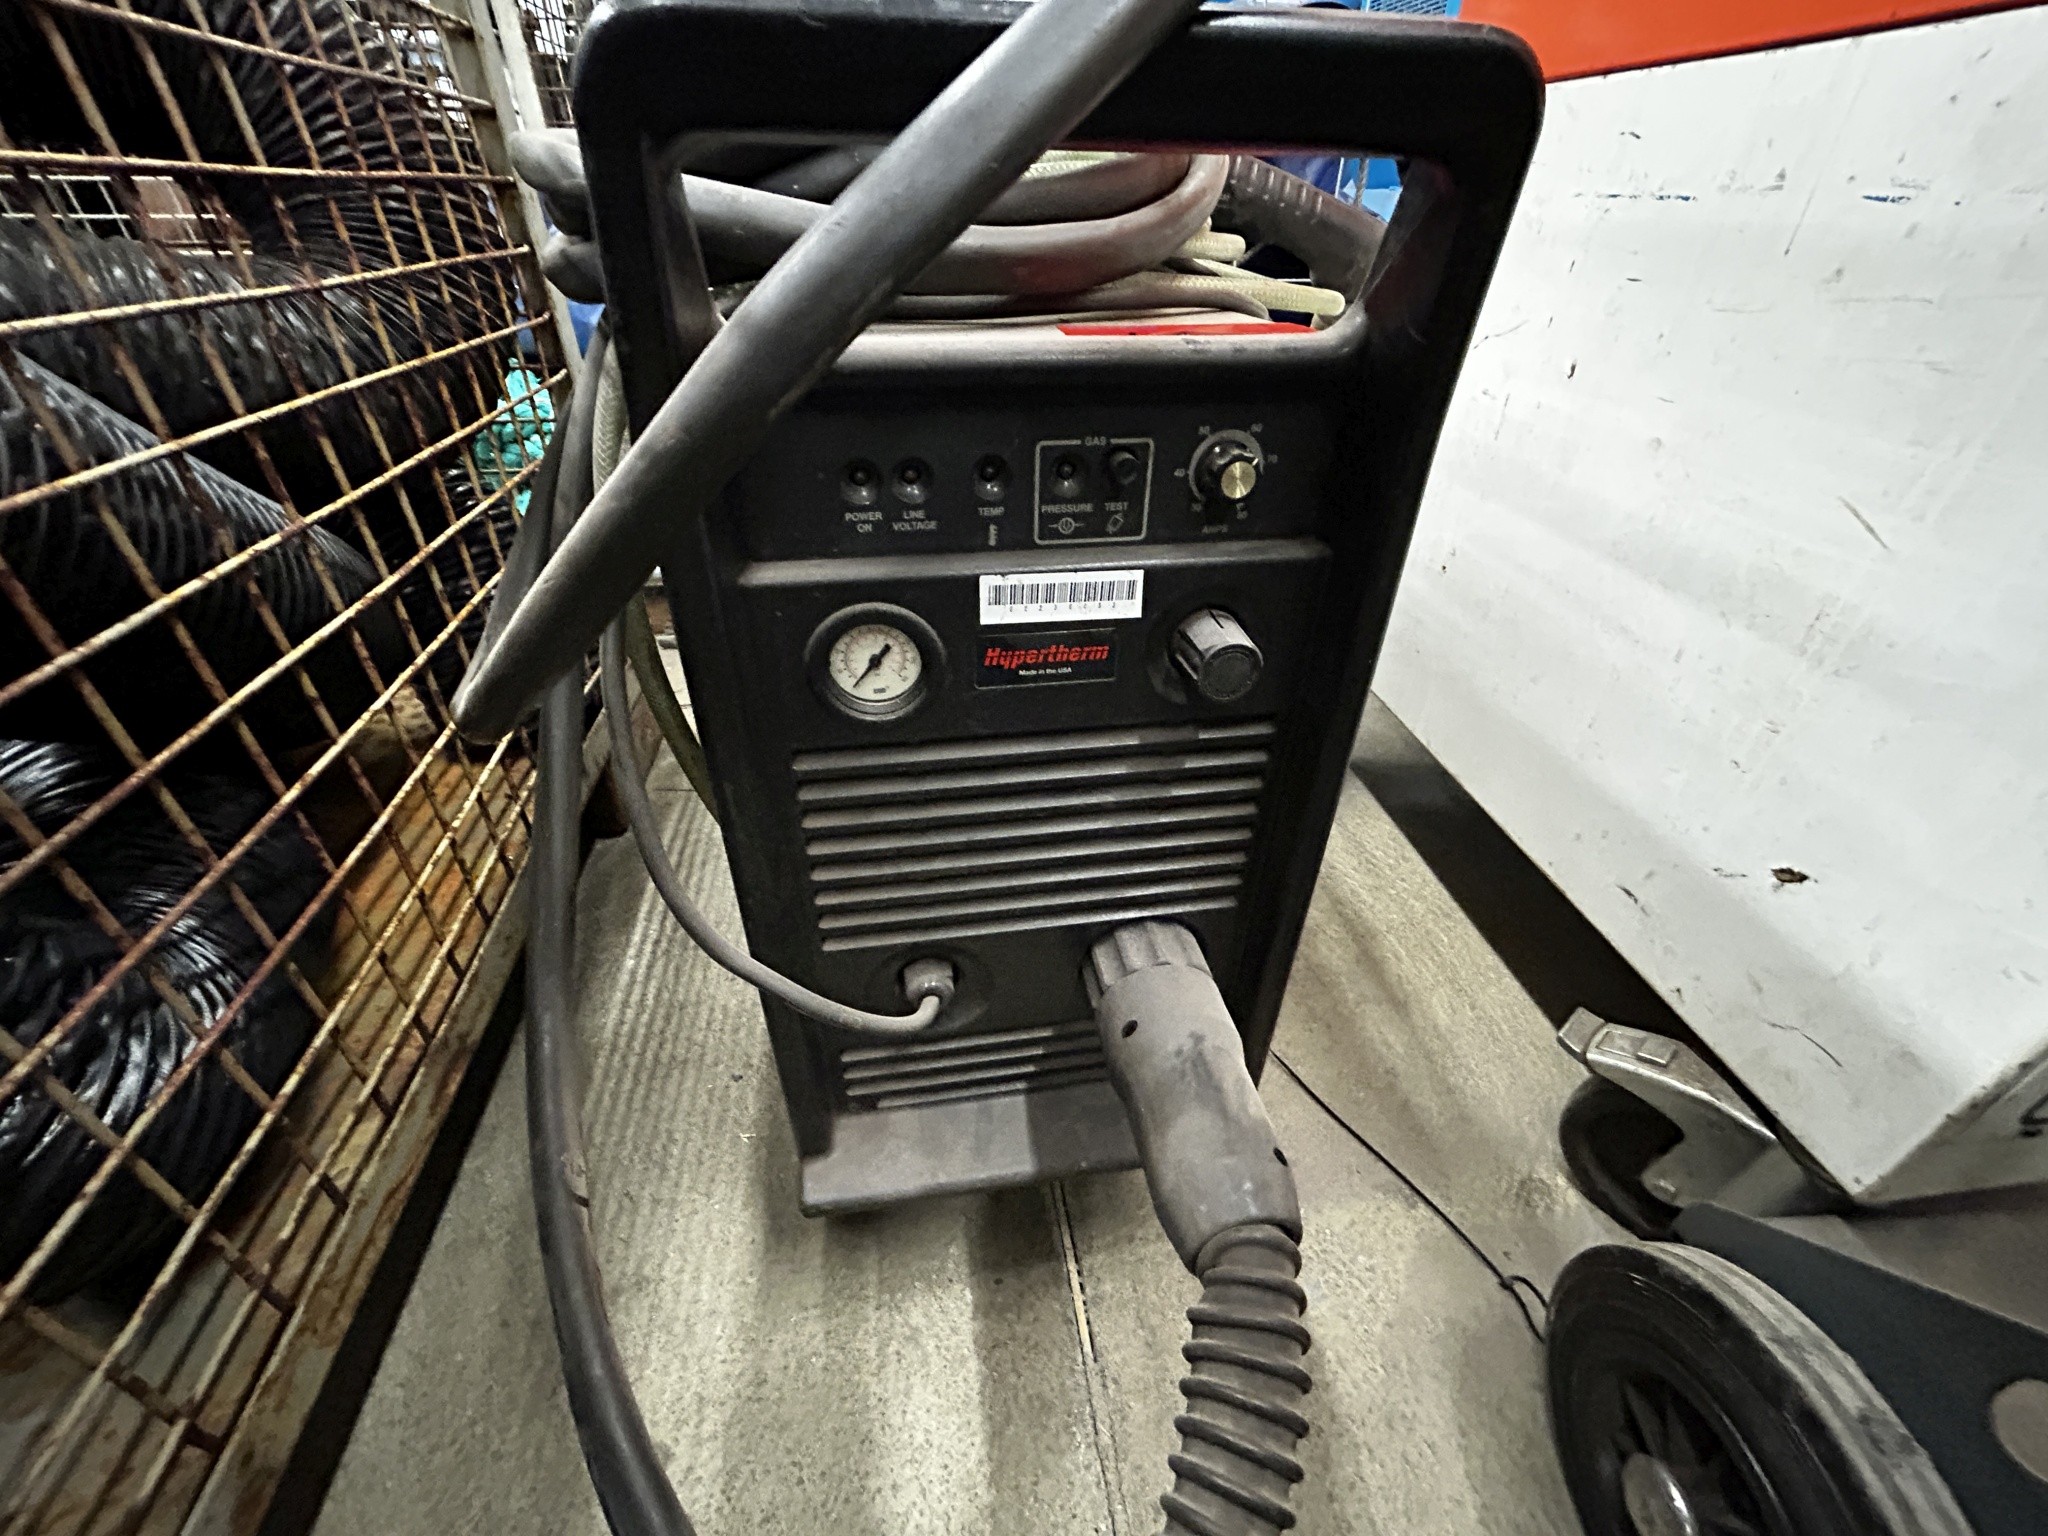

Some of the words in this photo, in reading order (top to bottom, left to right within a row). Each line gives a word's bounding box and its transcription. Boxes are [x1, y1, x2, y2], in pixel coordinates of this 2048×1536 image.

[1085, 436, 1107, 447] GAS
[977, 506, 1005, 516] TEMP
[1041, 503, 1093, 514] PRESSURE
[1104, 502, 1129, 512] TEST
[844, 511, 883, 522] POWER
[903, 509, 927, 520] LINE
[856, 523, 873, 533] ON
[892, 520, 938, 532] VOLTAGE
[984, 644, 1110, 670] Hypertherm
[1046, 667, 1056, 675] the
[1057, 666, 1072, 674] USA
